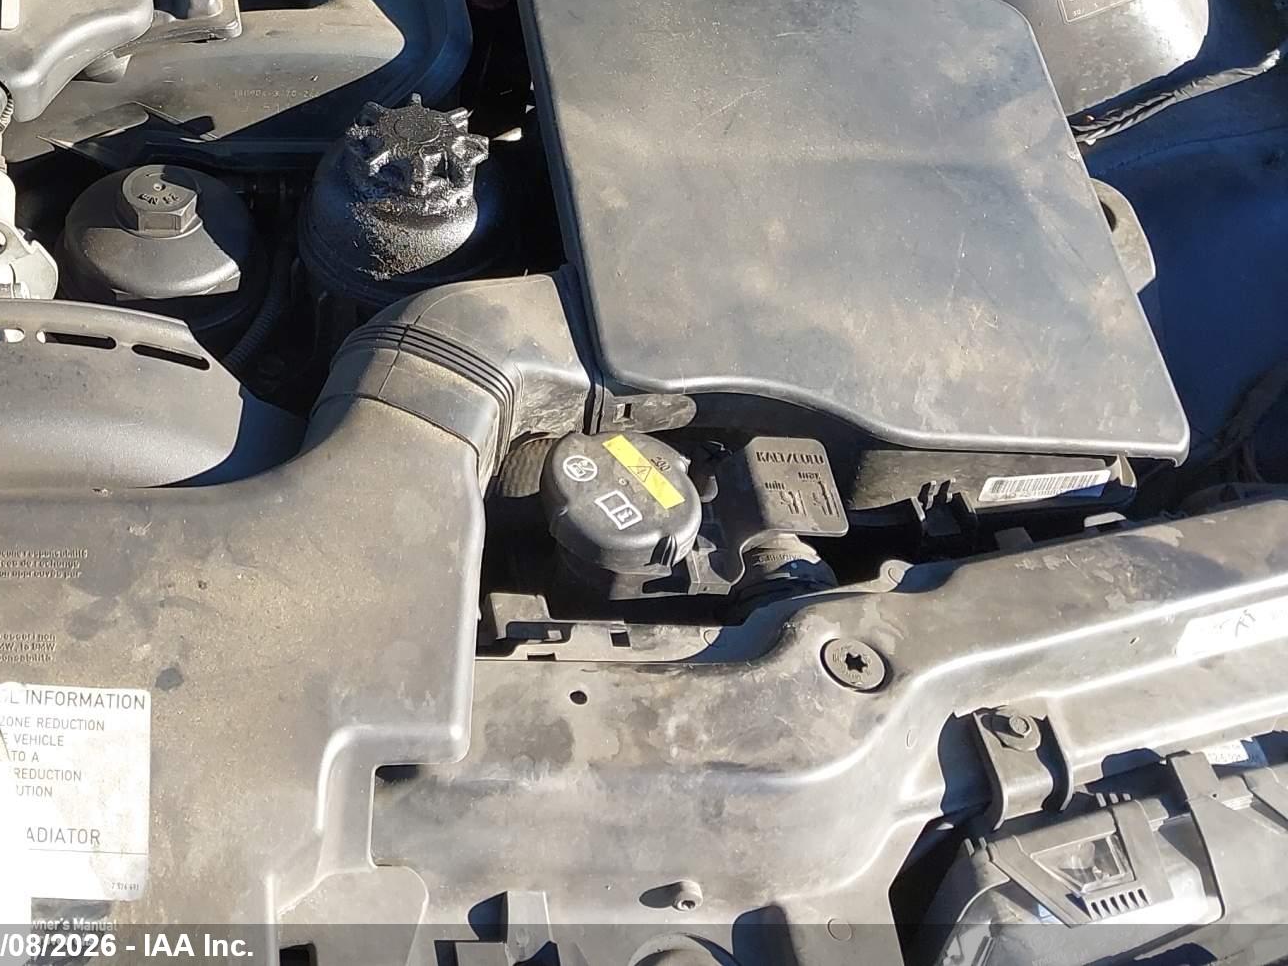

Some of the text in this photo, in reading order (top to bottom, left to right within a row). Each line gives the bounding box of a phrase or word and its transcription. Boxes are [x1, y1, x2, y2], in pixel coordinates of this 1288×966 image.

[756, 452, 824, 465] KALT/COLD
[25, 690, 145, 710] INFORMATION
[37, 717, 105, 731] REDUCTION
[14, 734, 64, 747] VEHICLE
[11, 751, 39, 762] TO A
[14, 768, 82, 781] REDUCTION
[73, 918, 117, 931] Manual
